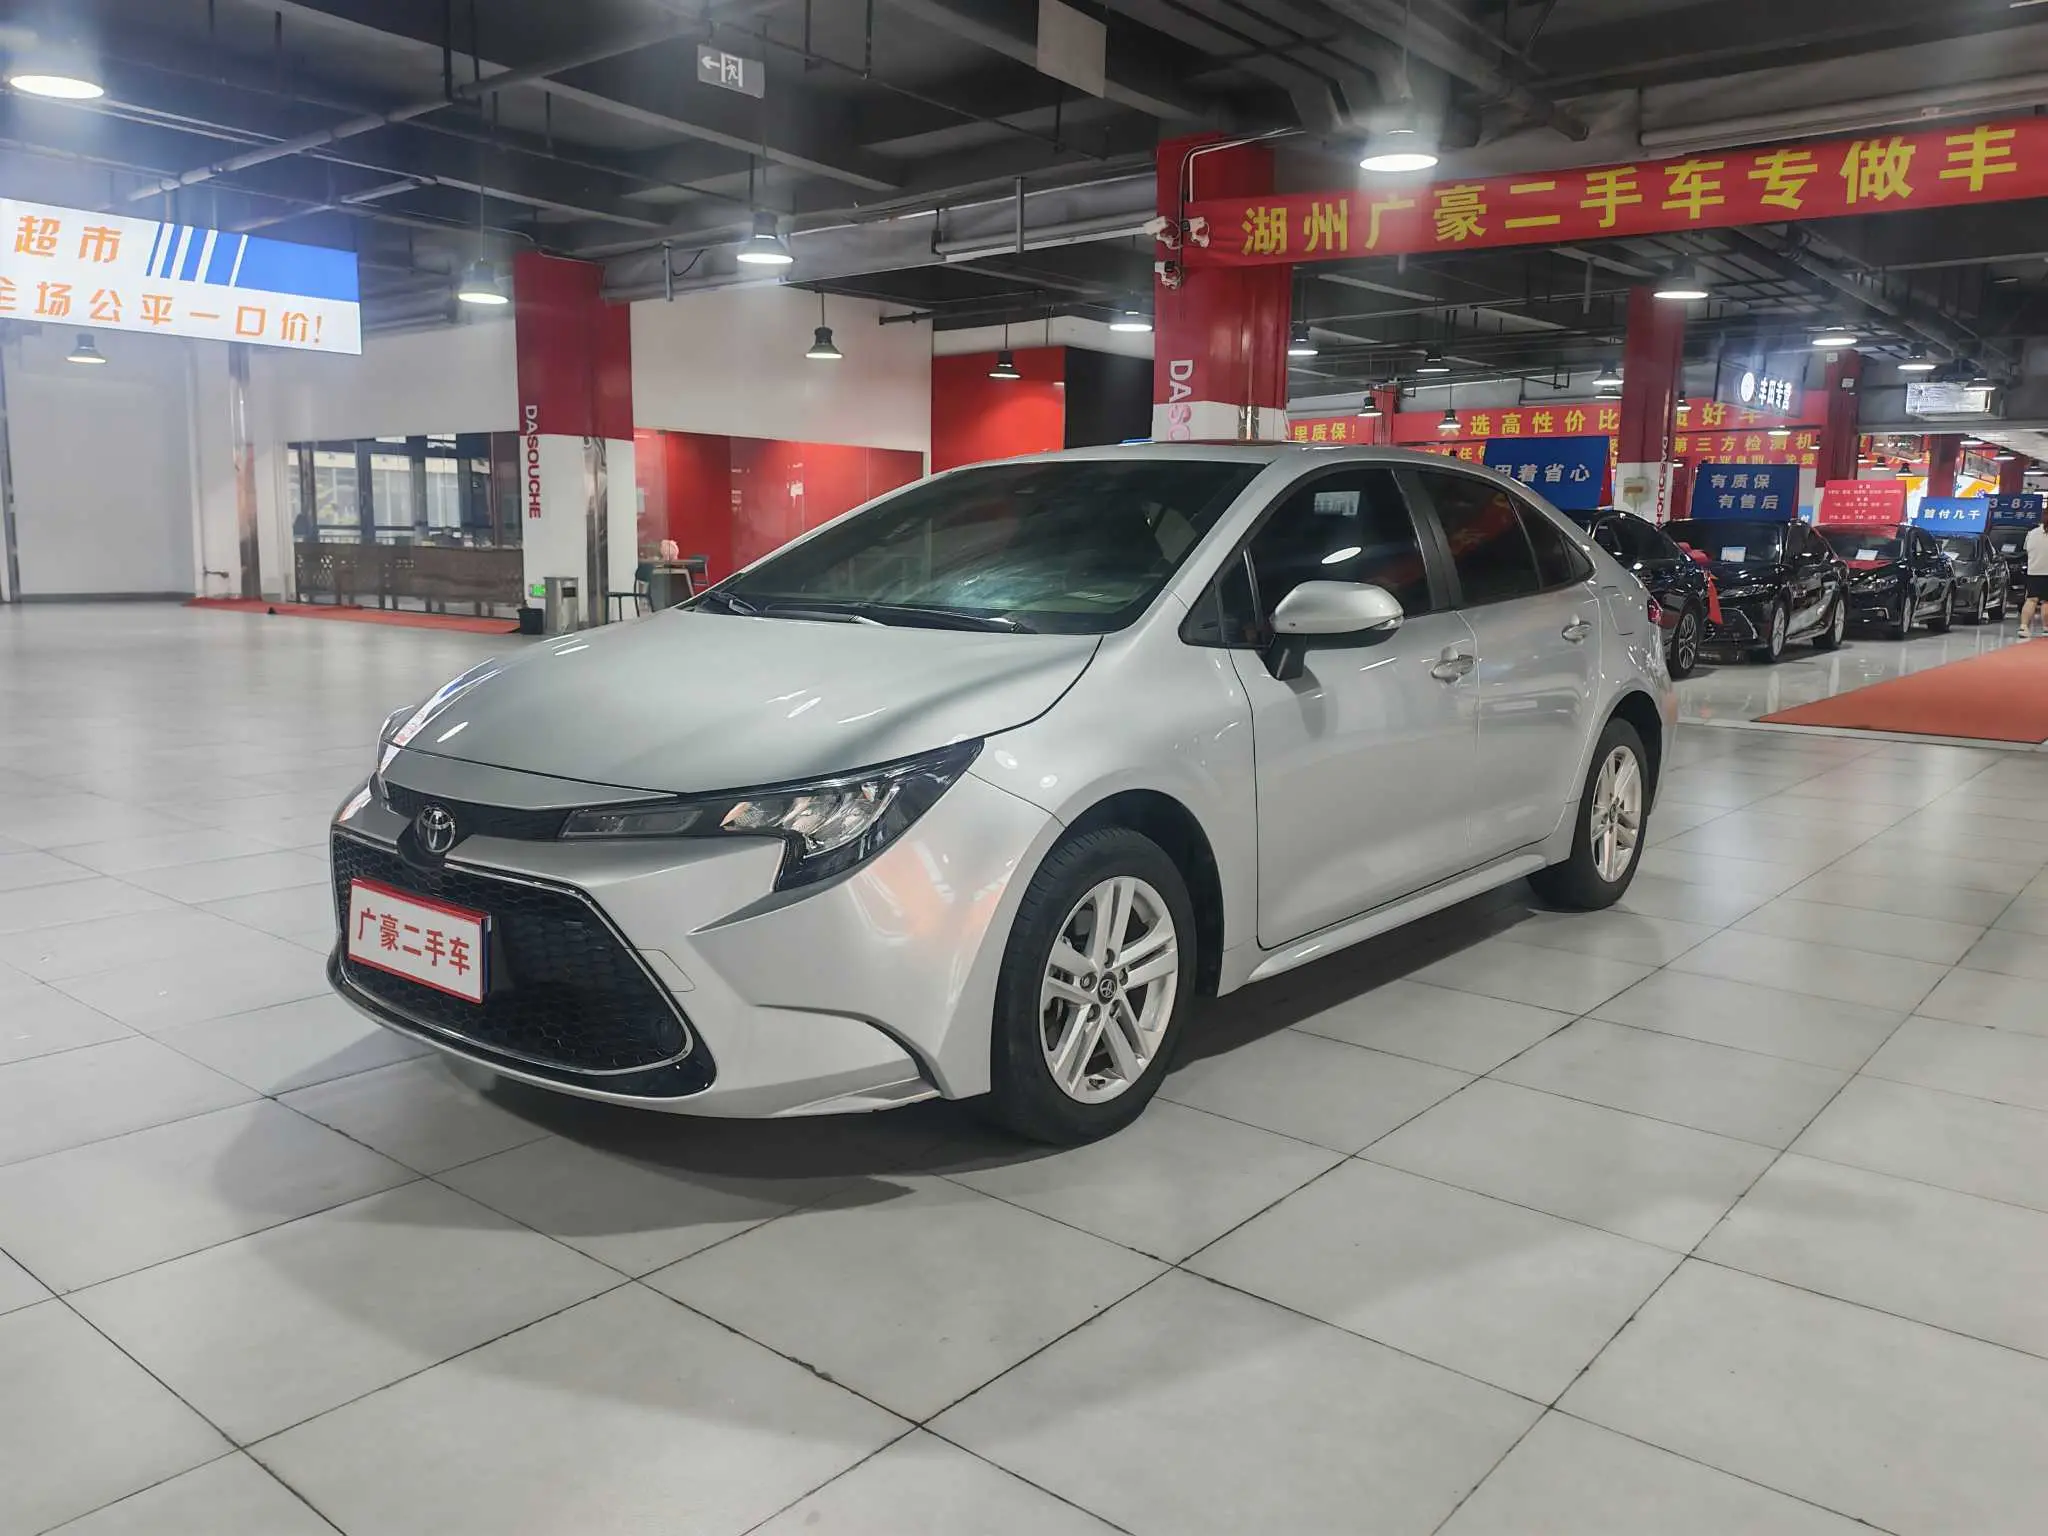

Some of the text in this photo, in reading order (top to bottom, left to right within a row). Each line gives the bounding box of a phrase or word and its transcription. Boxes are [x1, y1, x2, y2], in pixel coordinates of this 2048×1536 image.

[1241, 125, 2018, 256] 湖州广豪二手车专做丰
[14, 215, 123, 263] 超市
[525, 404, 541, 519] DASOUCHE
[1711, 473, 1771, 489] 有质保
[1719, 493, 1779, 510] 有售后
[358, 908, 470, 976] 广豪二手车
